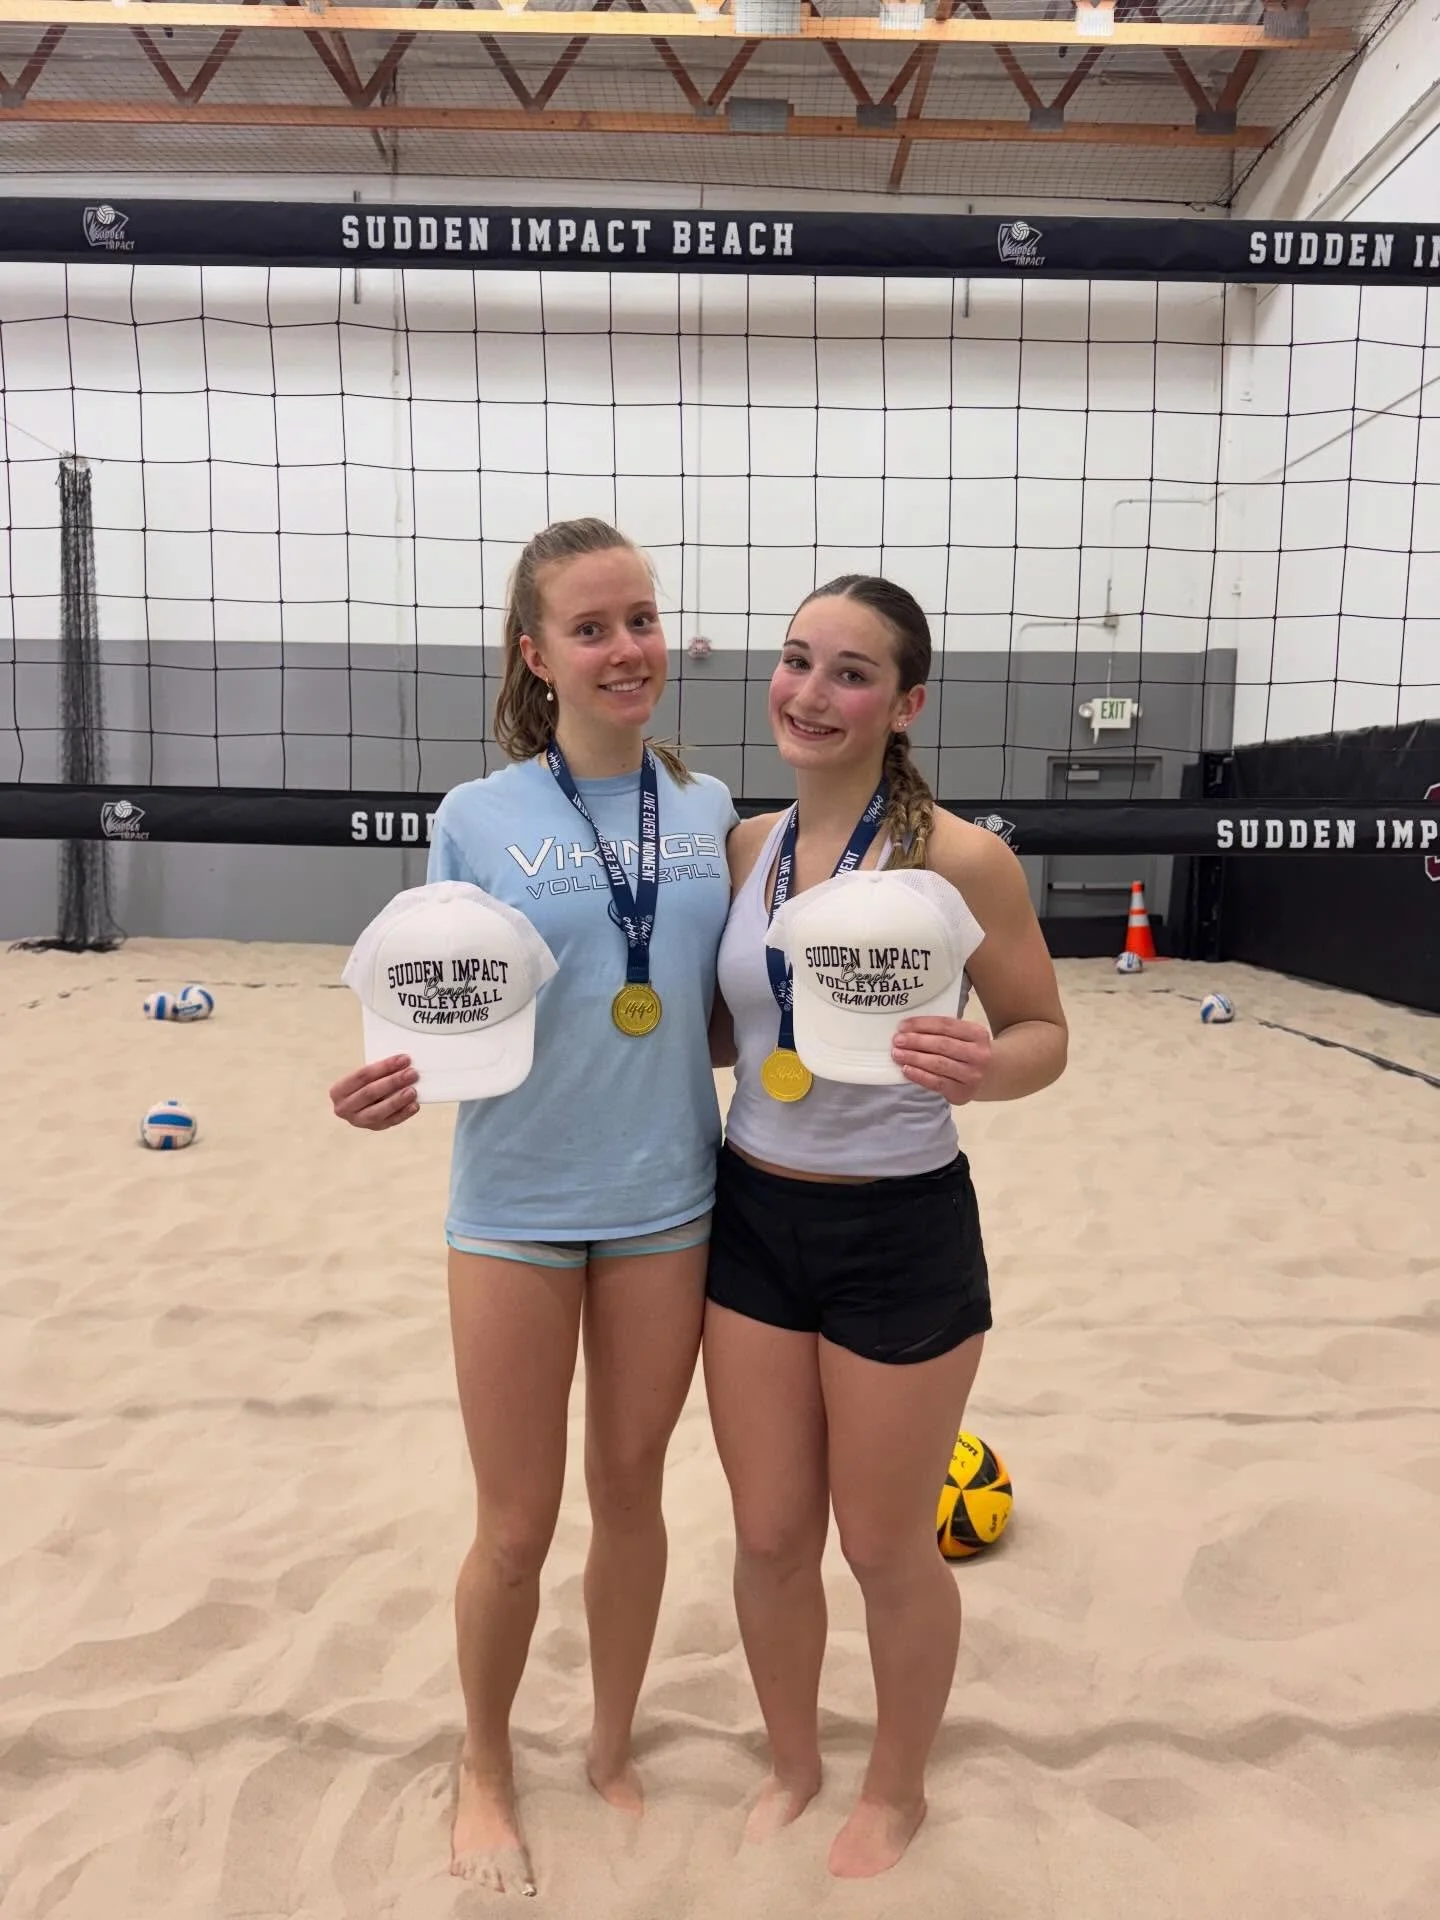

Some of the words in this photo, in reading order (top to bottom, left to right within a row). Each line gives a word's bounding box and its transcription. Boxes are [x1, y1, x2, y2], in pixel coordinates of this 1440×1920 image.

[342, 215, 489, 251] SUDDEN
[511, 218, 651, 253] IMPACT
[673, 222, 794, 257] BEACH
[1249, 231, 1394, 267] SUDDEN
[1100, 700, 1126, 720] EXIT
[643, 791, 656, 812] LIVE
[642, 812, 656, 840] EVERY
[1217, 818, 1356, 849] SUDDEN
[1376, 819, 1438, 849] IMP
[608, 863, 626, 886] LIVE
[641, 841, 656, 884] MOMENT
[779, 854, 792, 877] LIVE
[526, 863, 721, 900] VOLLBALL
[805, 945, 861, 968] SUDDEN
[868, 947, 931, 971] IMPACT
[387, 960, 444, 989] SUDDEN
[451, 958, 509, 984] IMPACT
[815, 972, 924, 993] VOLLEYBALL
[397, 989, 503, 1010] VOLLEYBALL
[831, 991, 910, 1007] CHAMPIONS
[412, 1006, 489, 1025] CHAMPIONS
